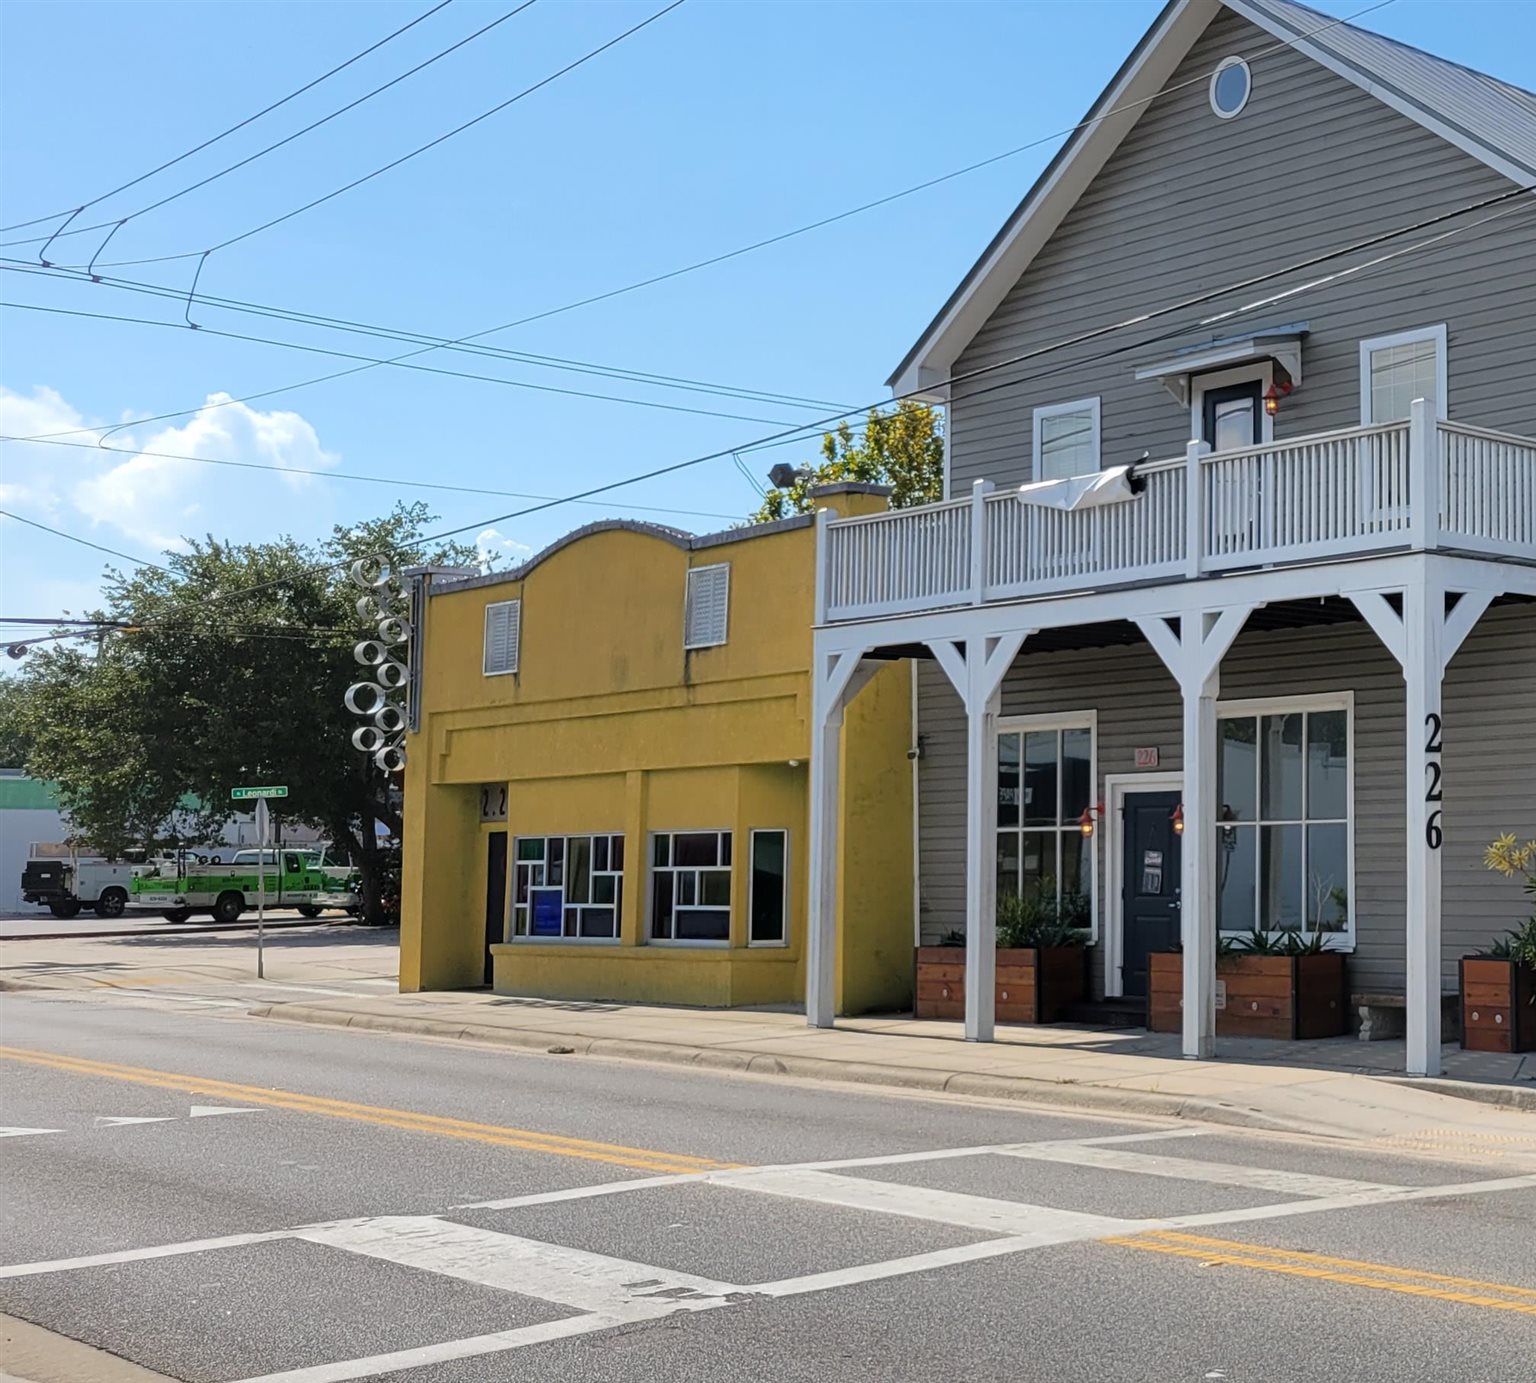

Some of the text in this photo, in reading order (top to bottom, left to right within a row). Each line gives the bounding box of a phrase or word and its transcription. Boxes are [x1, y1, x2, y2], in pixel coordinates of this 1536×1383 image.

[1137, 749, 1157, 767] 226
[1425, 713, 1443, 850] 226
[242, 788, 277, 799] Leonardi
